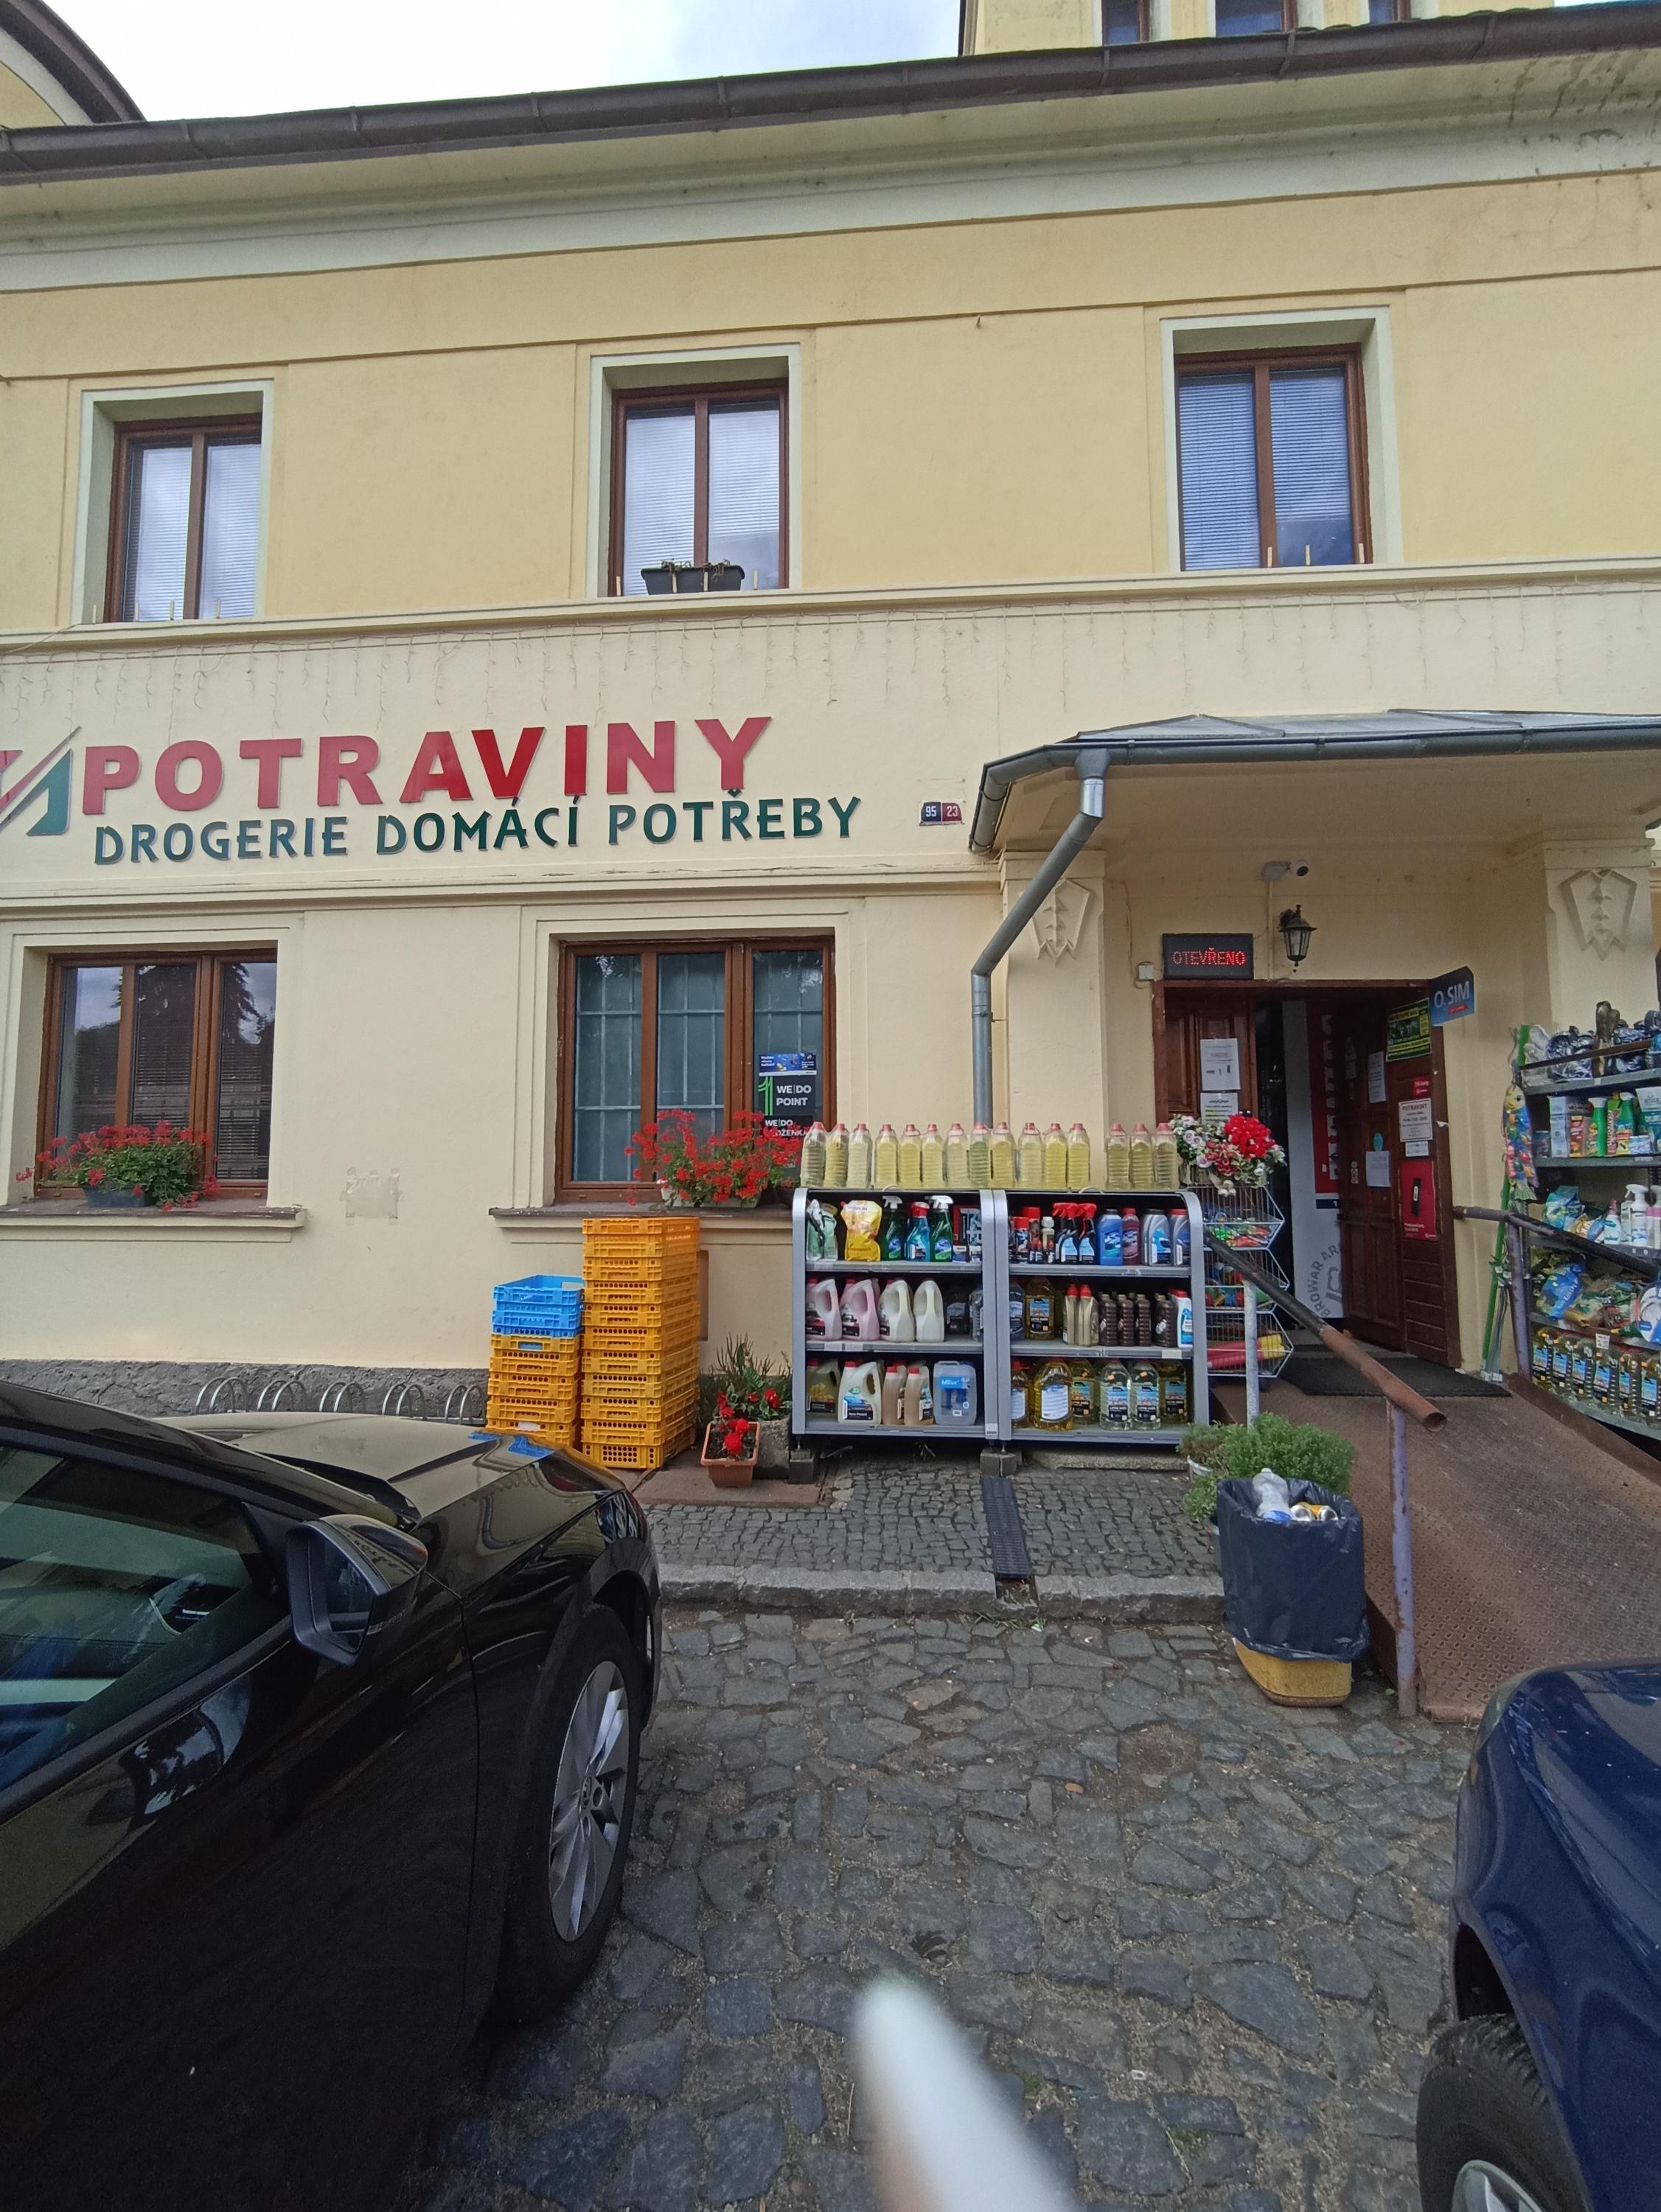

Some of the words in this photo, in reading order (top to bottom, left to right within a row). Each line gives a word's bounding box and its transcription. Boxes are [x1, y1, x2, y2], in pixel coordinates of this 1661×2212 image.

[82, 716, 773, 815] POTRAVINY
[925, 805, 937, 817] 95
[947, 805, 958, 817] 23
[94, 815, 349, 865] DROGERIE
[377, 793, 580, 855] DOMÁCÍ
[607, 788, 862, 846] POTŘEBY
[1172, 947, 1247, 966] OTEVŘENO
[1447, 981, 1469, 1005] SIM
[776, 1097, 808, 1106] POINT
